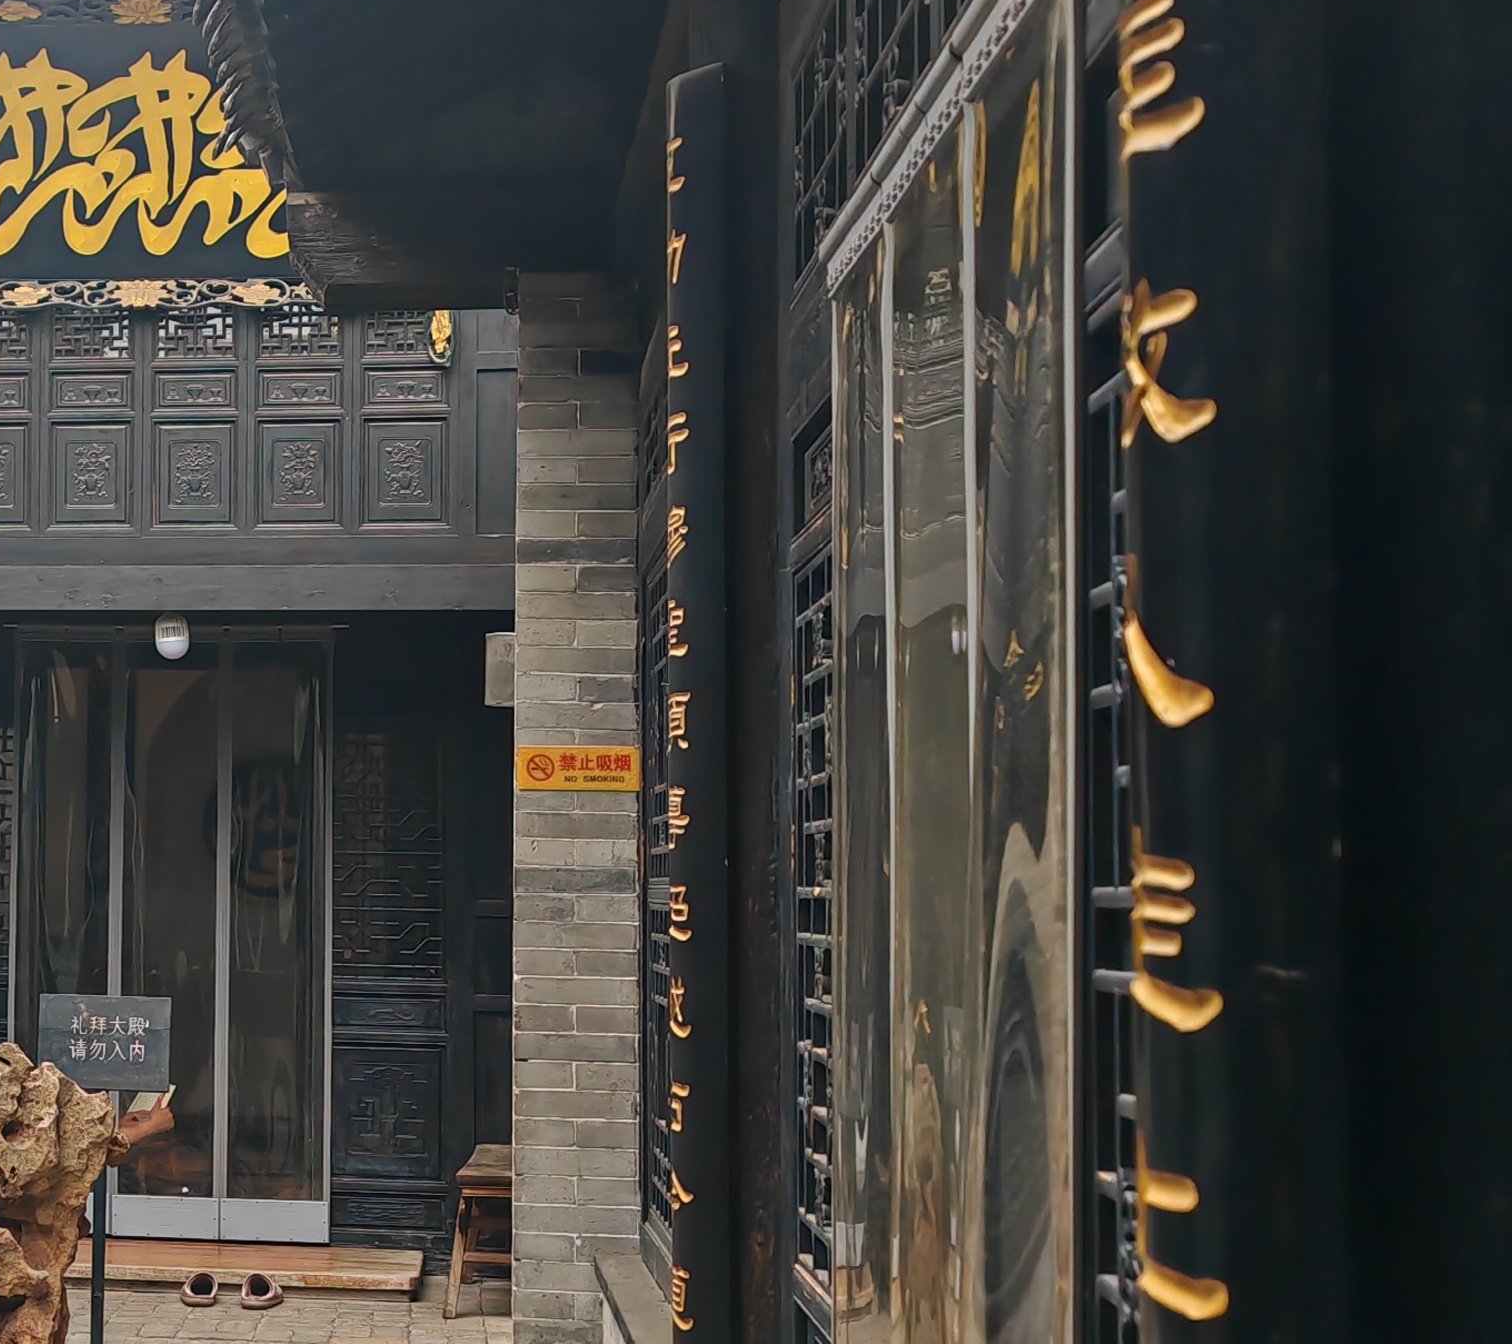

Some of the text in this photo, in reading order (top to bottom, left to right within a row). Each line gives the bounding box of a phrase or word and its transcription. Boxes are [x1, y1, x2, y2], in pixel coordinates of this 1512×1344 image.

[559, 753, 631, 772] 禁止吸烟
[564, 775, 625, 783] NO SMOKING
[70, 1016, 147, 1036] 礼拜大殿
[69, 1039, 145, 1062] 请勿入内
